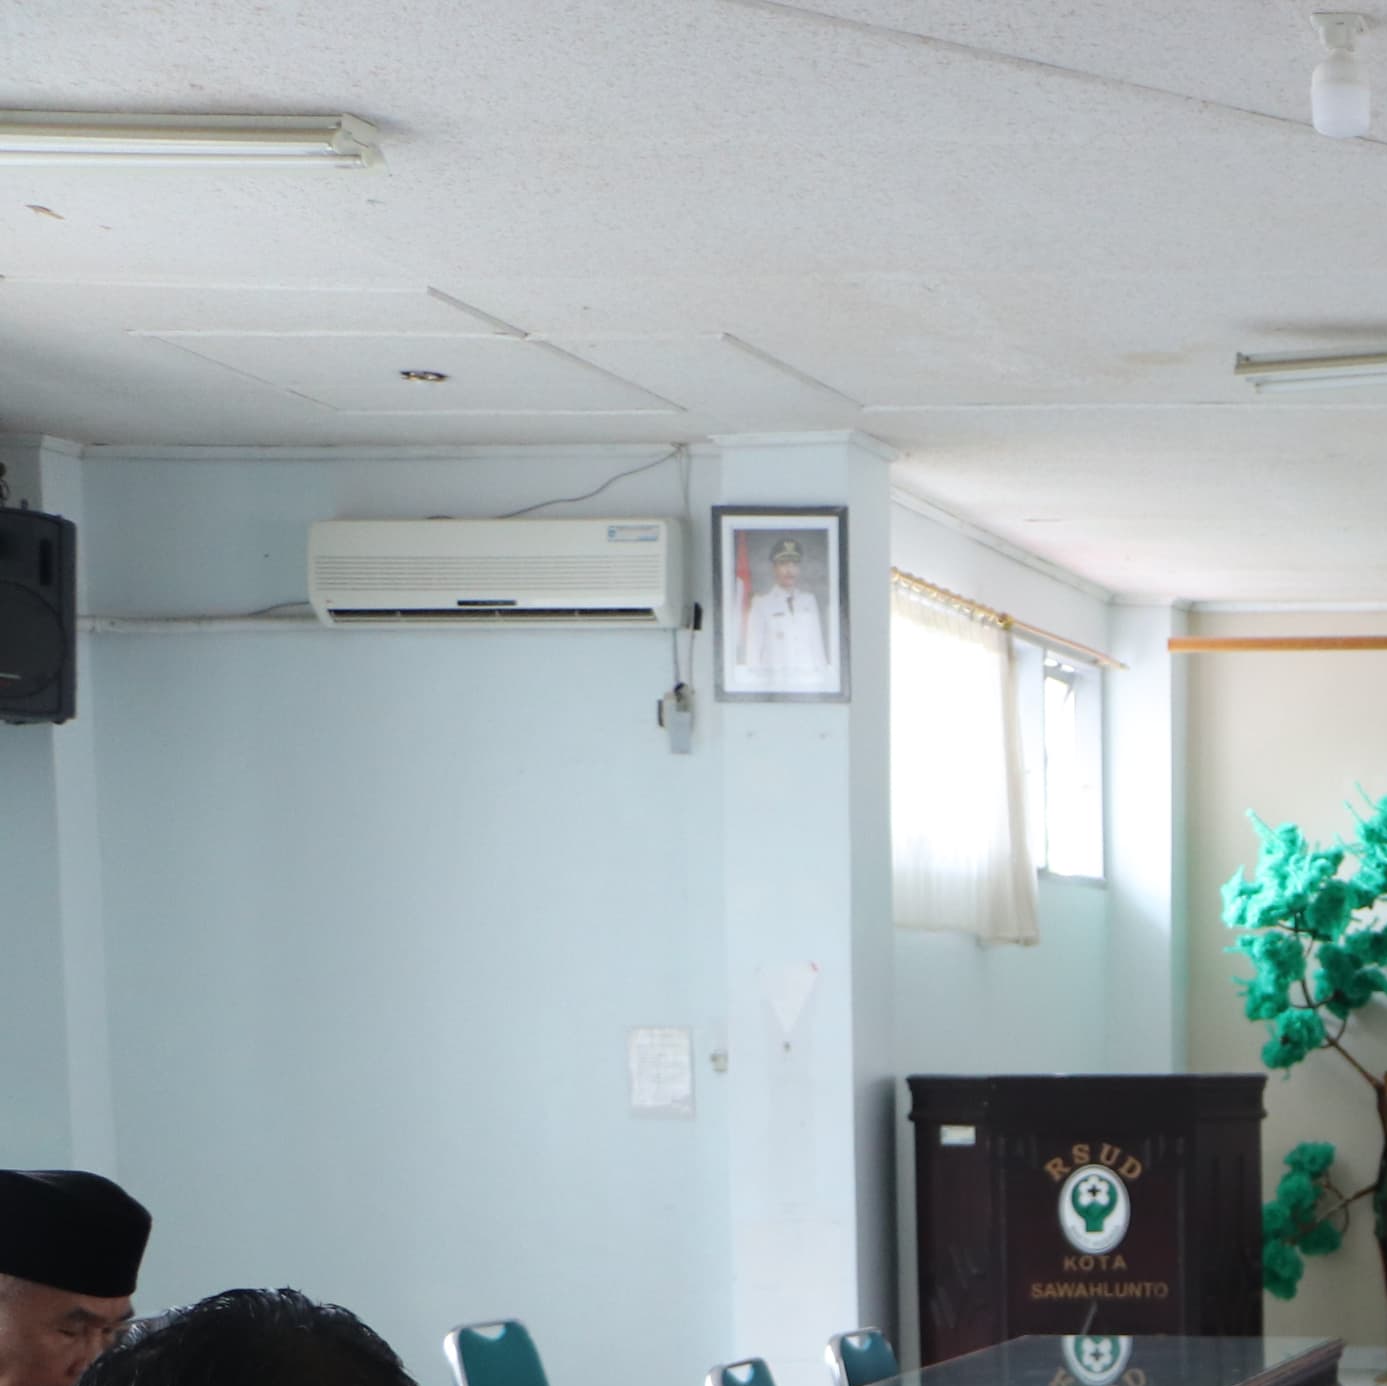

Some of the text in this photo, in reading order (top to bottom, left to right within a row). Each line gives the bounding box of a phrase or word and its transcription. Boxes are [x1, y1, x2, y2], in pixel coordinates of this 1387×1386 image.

[1044, 1144, 1142, 1181] RSUD
[1063, 1256, 1128, 1271] KOTA
[1031, 1282, 1169, 1298] SAWAHLUNTO
